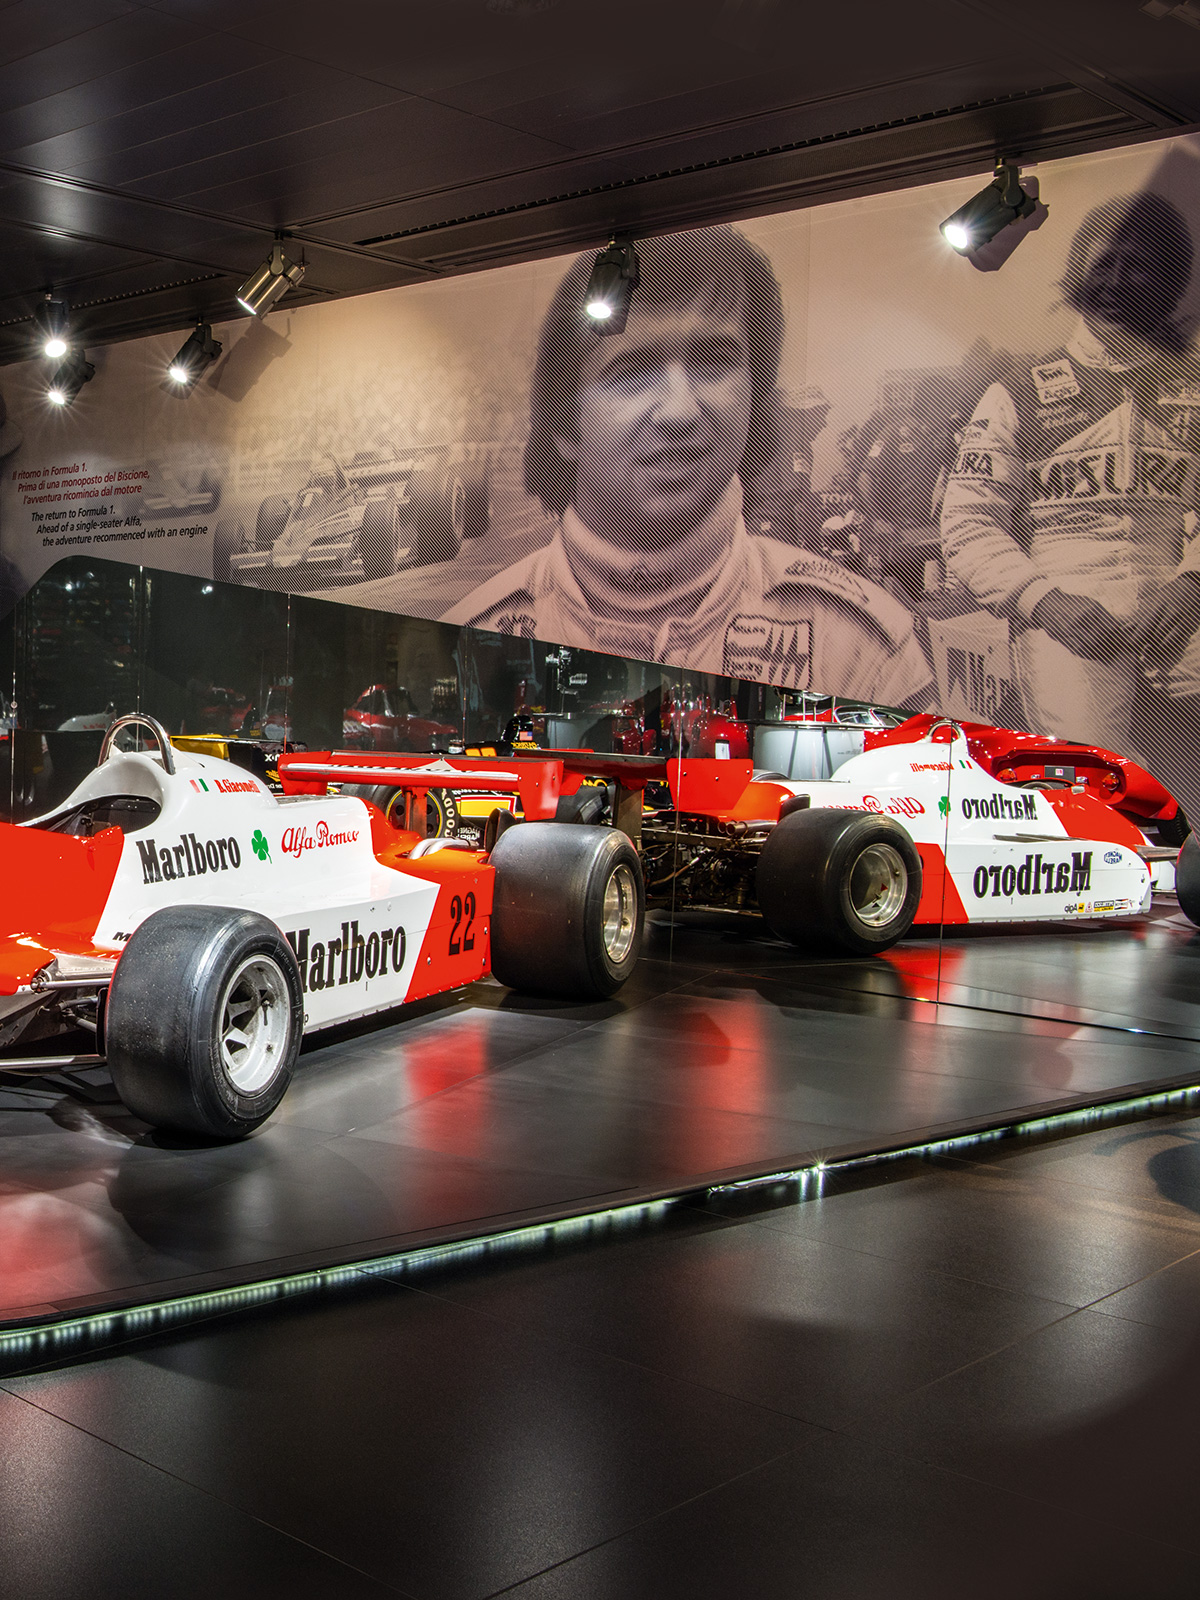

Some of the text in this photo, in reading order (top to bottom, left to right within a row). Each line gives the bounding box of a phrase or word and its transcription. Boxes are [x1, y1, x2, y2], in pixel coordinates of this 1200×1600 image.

[17, 469, 40, 480] ritorno
[43, 468, 50, 477] in
[51, 463, 80, 476] Formula
[81, 462, 88, 472] 1.
[17, 469, 150, 492] Prima di una monoposto del Biscione,
[23, 484, 143, 505] l'avventura ricomincia dal motore
[31, 504, 116, 522] The return to Formula 1.
[36, 523, 59, 534] Ahead
[60, 521, 70, 532] of
[76, 518, 123, 532] single-seater
[124, 516, 142, 527] Alfa,
[42, 524, 208, 547] the adventure recommenced with an engine
[281, 820, 360, 858] Alfa Romeo
[136, 833, 242, 885] Marlboro
[448, 891, 476, 957] 22
[286, 920, 407, 995] Marlboro
